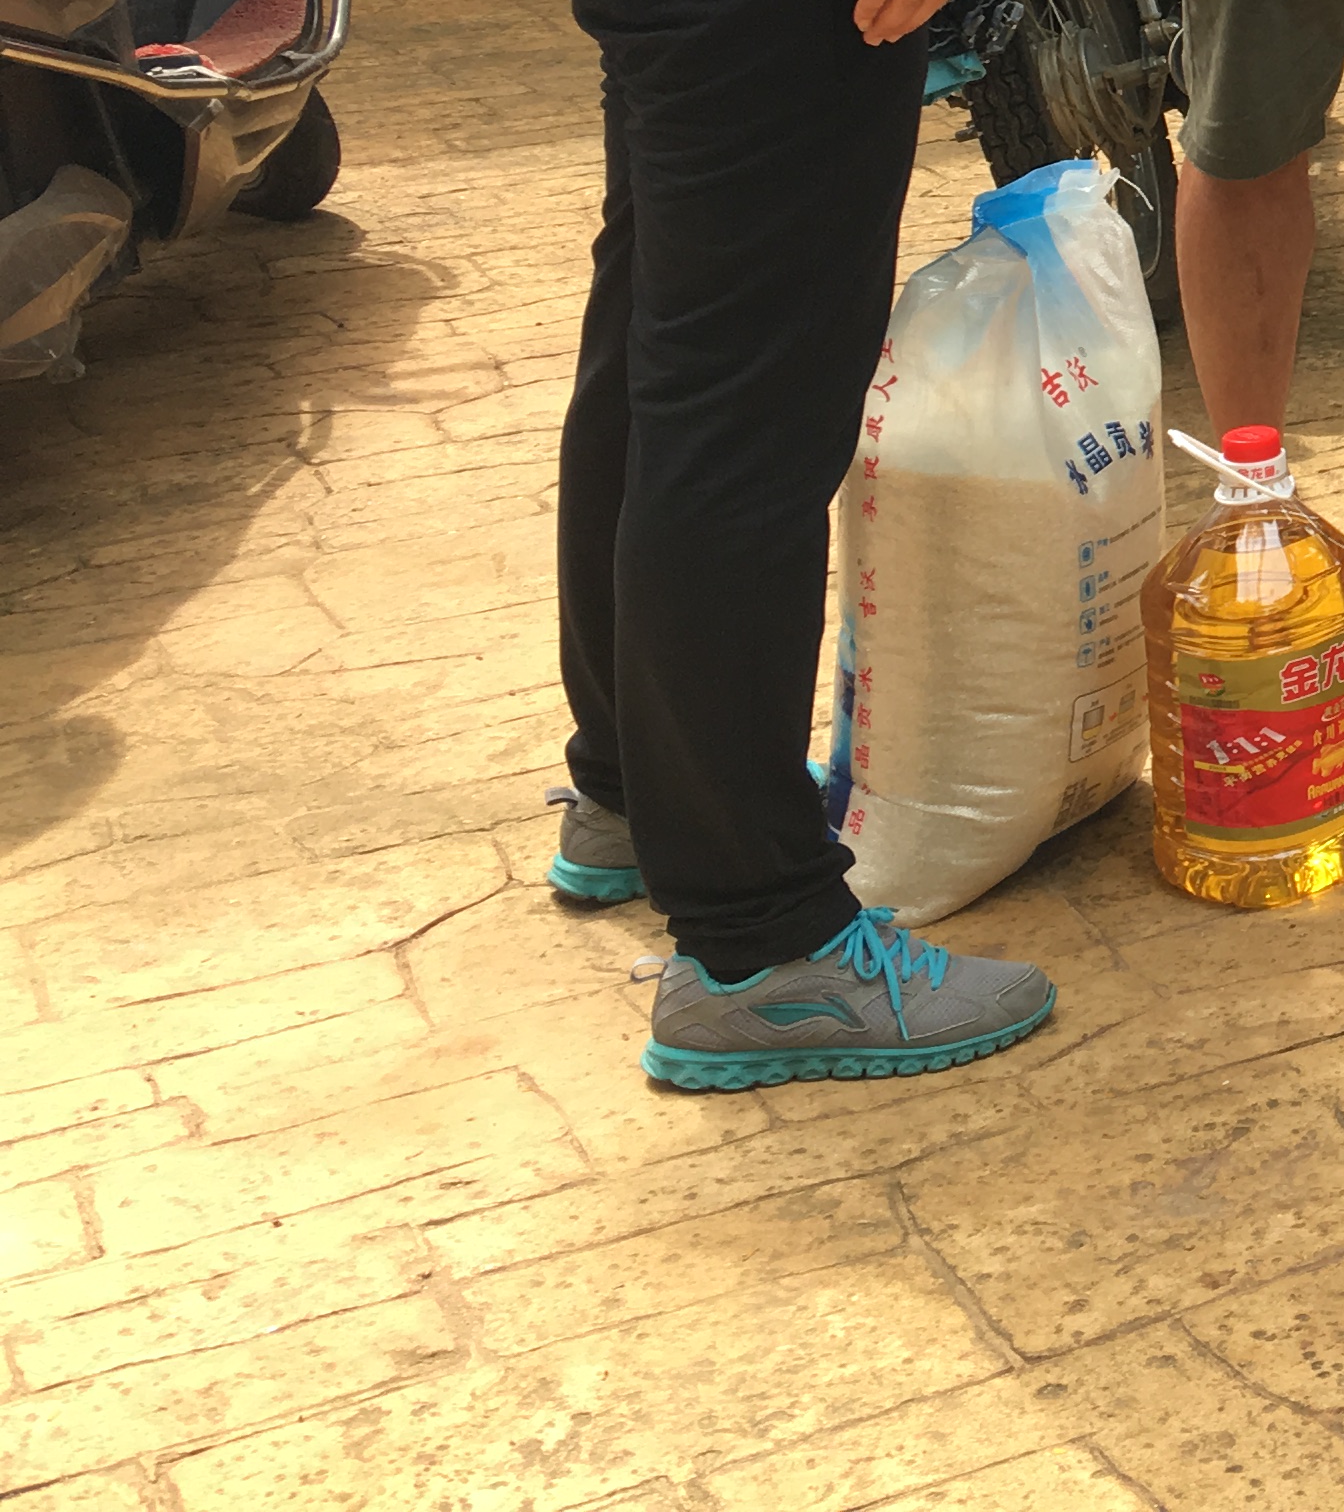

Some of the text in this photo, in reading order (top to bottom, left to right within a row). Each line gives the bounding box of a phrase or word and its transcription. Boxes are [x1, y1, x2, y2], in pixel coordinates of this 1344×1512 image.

[1040, 355, 1099, 409] 吉沃
[1064, 419, 1155, 496] 水晶贡米
